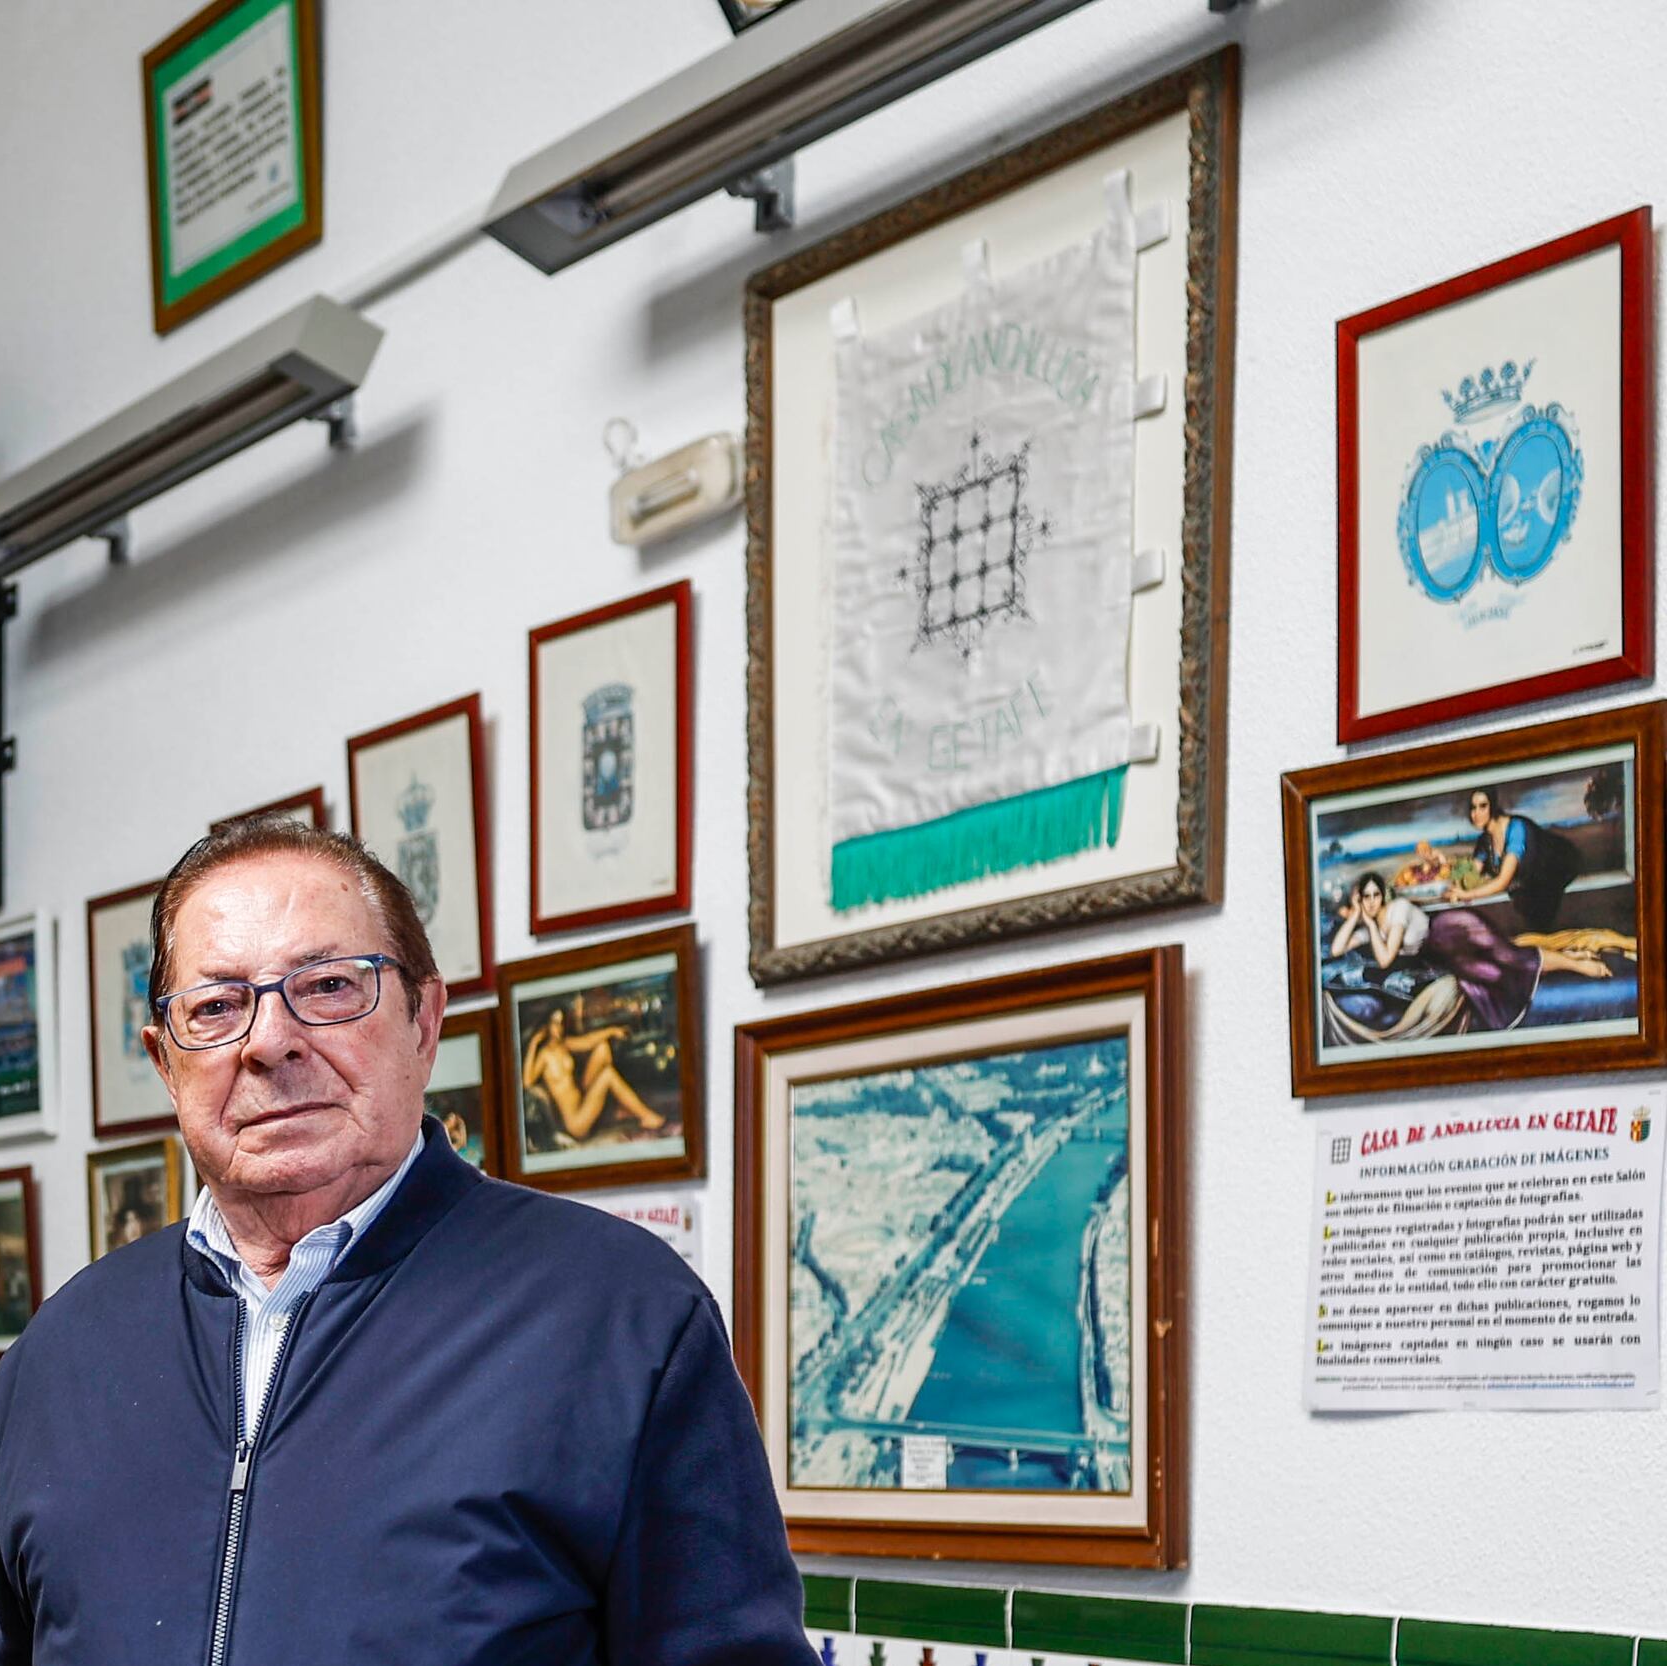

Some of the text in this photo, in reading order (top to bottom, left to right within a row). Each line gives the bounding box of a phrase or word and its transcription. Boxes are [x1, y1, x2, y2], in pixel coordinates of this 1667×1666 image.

[1360, 1128, 1399, 1156] CASA
[1406, 1125, 1425, 1145] DE
[1527, 1113, 1548, 1130] EN
[1553, 1106, 1618, 1135] GETAFE
[1360, 1146, 1609, 1178] INFORMACIÓN GRABACIÓN DE IMÁGENES
[1341, 1188, 1401, 1203] informamos
[1405, 1187, 1423, 1200] que
[1428, 1184, 1442, 1195] los
[1445, 1182, 1482, 1195] eventos
[1485, 1181, 1504, 1194] que
[1508, 1180, 1518, 1190] se
[1521, 1174, 1569, 1189] celebran
[1572, 1175, 1587, 1186] en
[1590, 1171, 1614, 1184] este
[1616, 1168, 1646, 1182] Salón
[1343, 1204, 1374, 1219] objeto
[1377, 1202, 1390, 1214] de
[1393, 1199, 1442, 1213] filmación
[1454, 1193, 1502, 1210] captación
[1505, 1194, 1517, 1206] de
[1343, 1225, 1392, 1238] imágenes
[1396, 1220, 1455, 1235] registradas
[1524, 1213, 1564, 1228] podrán
[1568, 1212, 1586, 1223] ser
[1591, 1208, 1644, 1222] utilizadas
[1331, 1238, 1386, 1254] publicadas
[1392, 1239, 1406, 1249] en
[1411, 1236, 1459, 1249] cualquier
[1464, 1231, 1523, 1248] publicación
[1574, 1226, 1624, 1240] inclusive
[1629, 1225, 1642, 1236] en
[1322, 1255, 1347, 1267] redes
[1418, 1252, 1446, 1262] como
[1449, 1251, 1461, 1261] en
[1568, 1242, 1608, 1257] página
[1611, 1239, 1633, 1252] web
[1635, 1242, 1643, 1255] y
[1321, 1256, 1642, 1281] otros medios de comunicación para promocionar las
[1320, 1283, 1375, 1297] actividades
[1378, 1282, 1392, 1294] de
[1395, 1282, 1405, 1294] la
[1453, 1280, 1475, 1290] todo
[1477, 1278, 1498, 1290] ello
[1500, 1279, 1518, 1289] con
[1520, 1276, 1566, 1289] carácter
[1569, 1274, 1618, 1289] gratuito.
[1332, 1305, 1344, 1317] no
[1349, 1303, 1380, 1316] desea
[1386, 1303, 1434, 1317] aparecer
[1439, 1302, 1452, 1312] en
[1457, 1300, 1489, 1312] dichas
[1494, 1297, 1572, 1315] publicaciones,
[1577, 1297, 1625, 1310] rogamos
[1630, 1293, 1641, 1306] lo
[1318, 1319, 1373, 1332] comunique
[1385, 1317, 1428, 1329] nuestro
[1430, 1315, 1475, 1330] personal
[1477, 1317, 1490, 1327] en
[1493, 1314, 1502, 1326] el
[1505, 1313, 1556, 1326] momento
[1558, 1312, 1573, 1324] de
[1576, 1313, 1589, 1324] su
[1592, 1310, 1638, 1323] entrada.
[1341, 1339, 1392, 1352] imágenes
[1401, 1338, 1449, 1352] captadas
[1456, 1338, 1468, 1348] en
[1476, 1336, 1512, 1350] ningún
[1520, 1336, 1544, 1347] caso
[1552, 1336, 1565, 1347] se
[1574, 1333, 1613, 1346] usarán
[1620, 1334, 1641, 1346] con
[1316, 1354, 1370, 1366] finalidades
